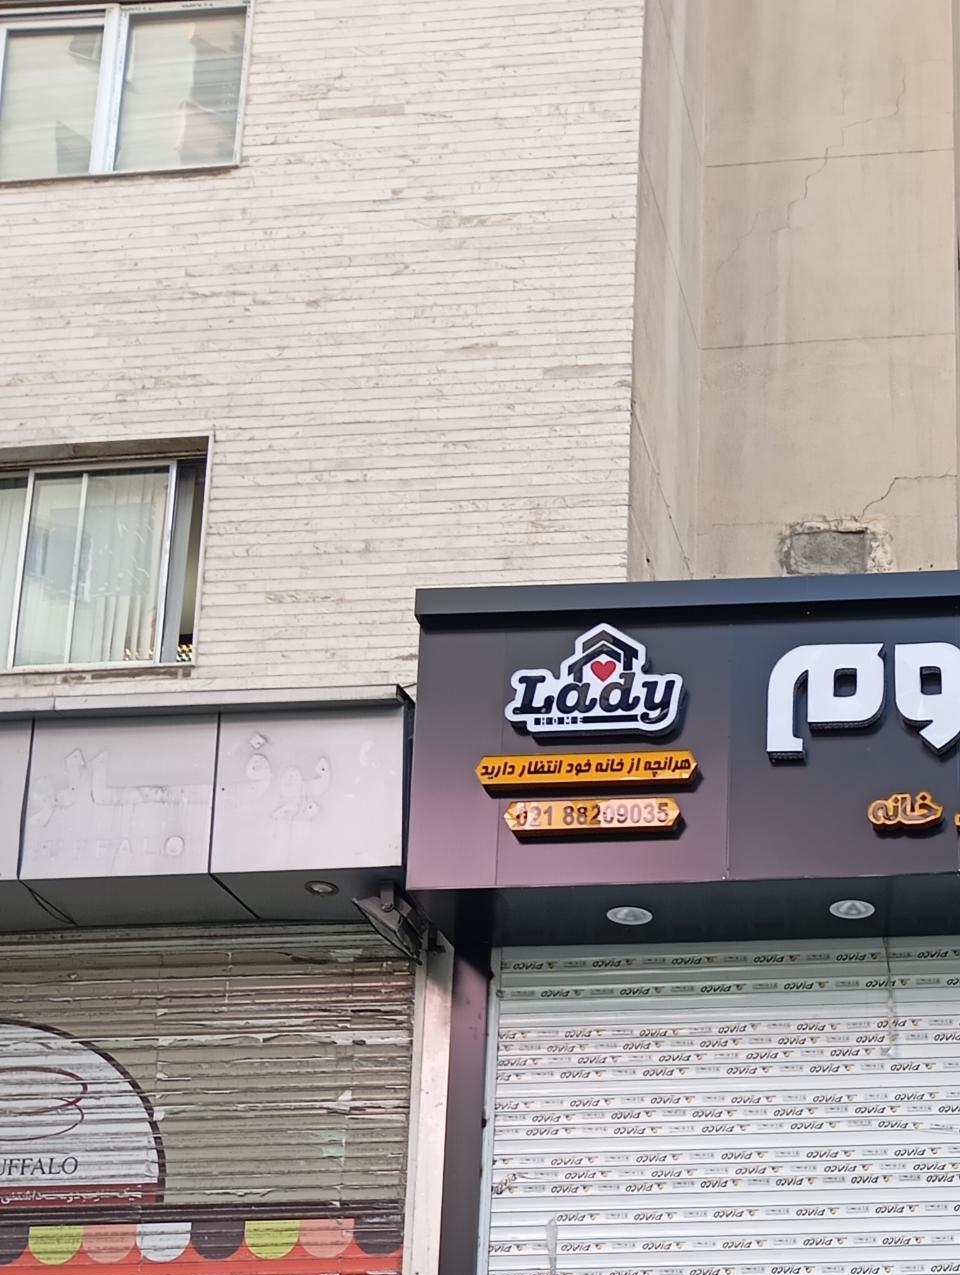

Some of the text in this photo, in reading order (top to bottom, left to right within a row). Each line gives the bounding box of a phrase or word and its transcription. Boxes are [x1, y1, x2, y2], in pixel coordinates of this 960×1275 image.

[513, 672, 676, 725] Lady
[480, 757, 692, 779] هرانچه از خانه خود انتظار دارید
[515, 802, 669, 826] 021 88209035
[867, 791, 943, 827] خانه
